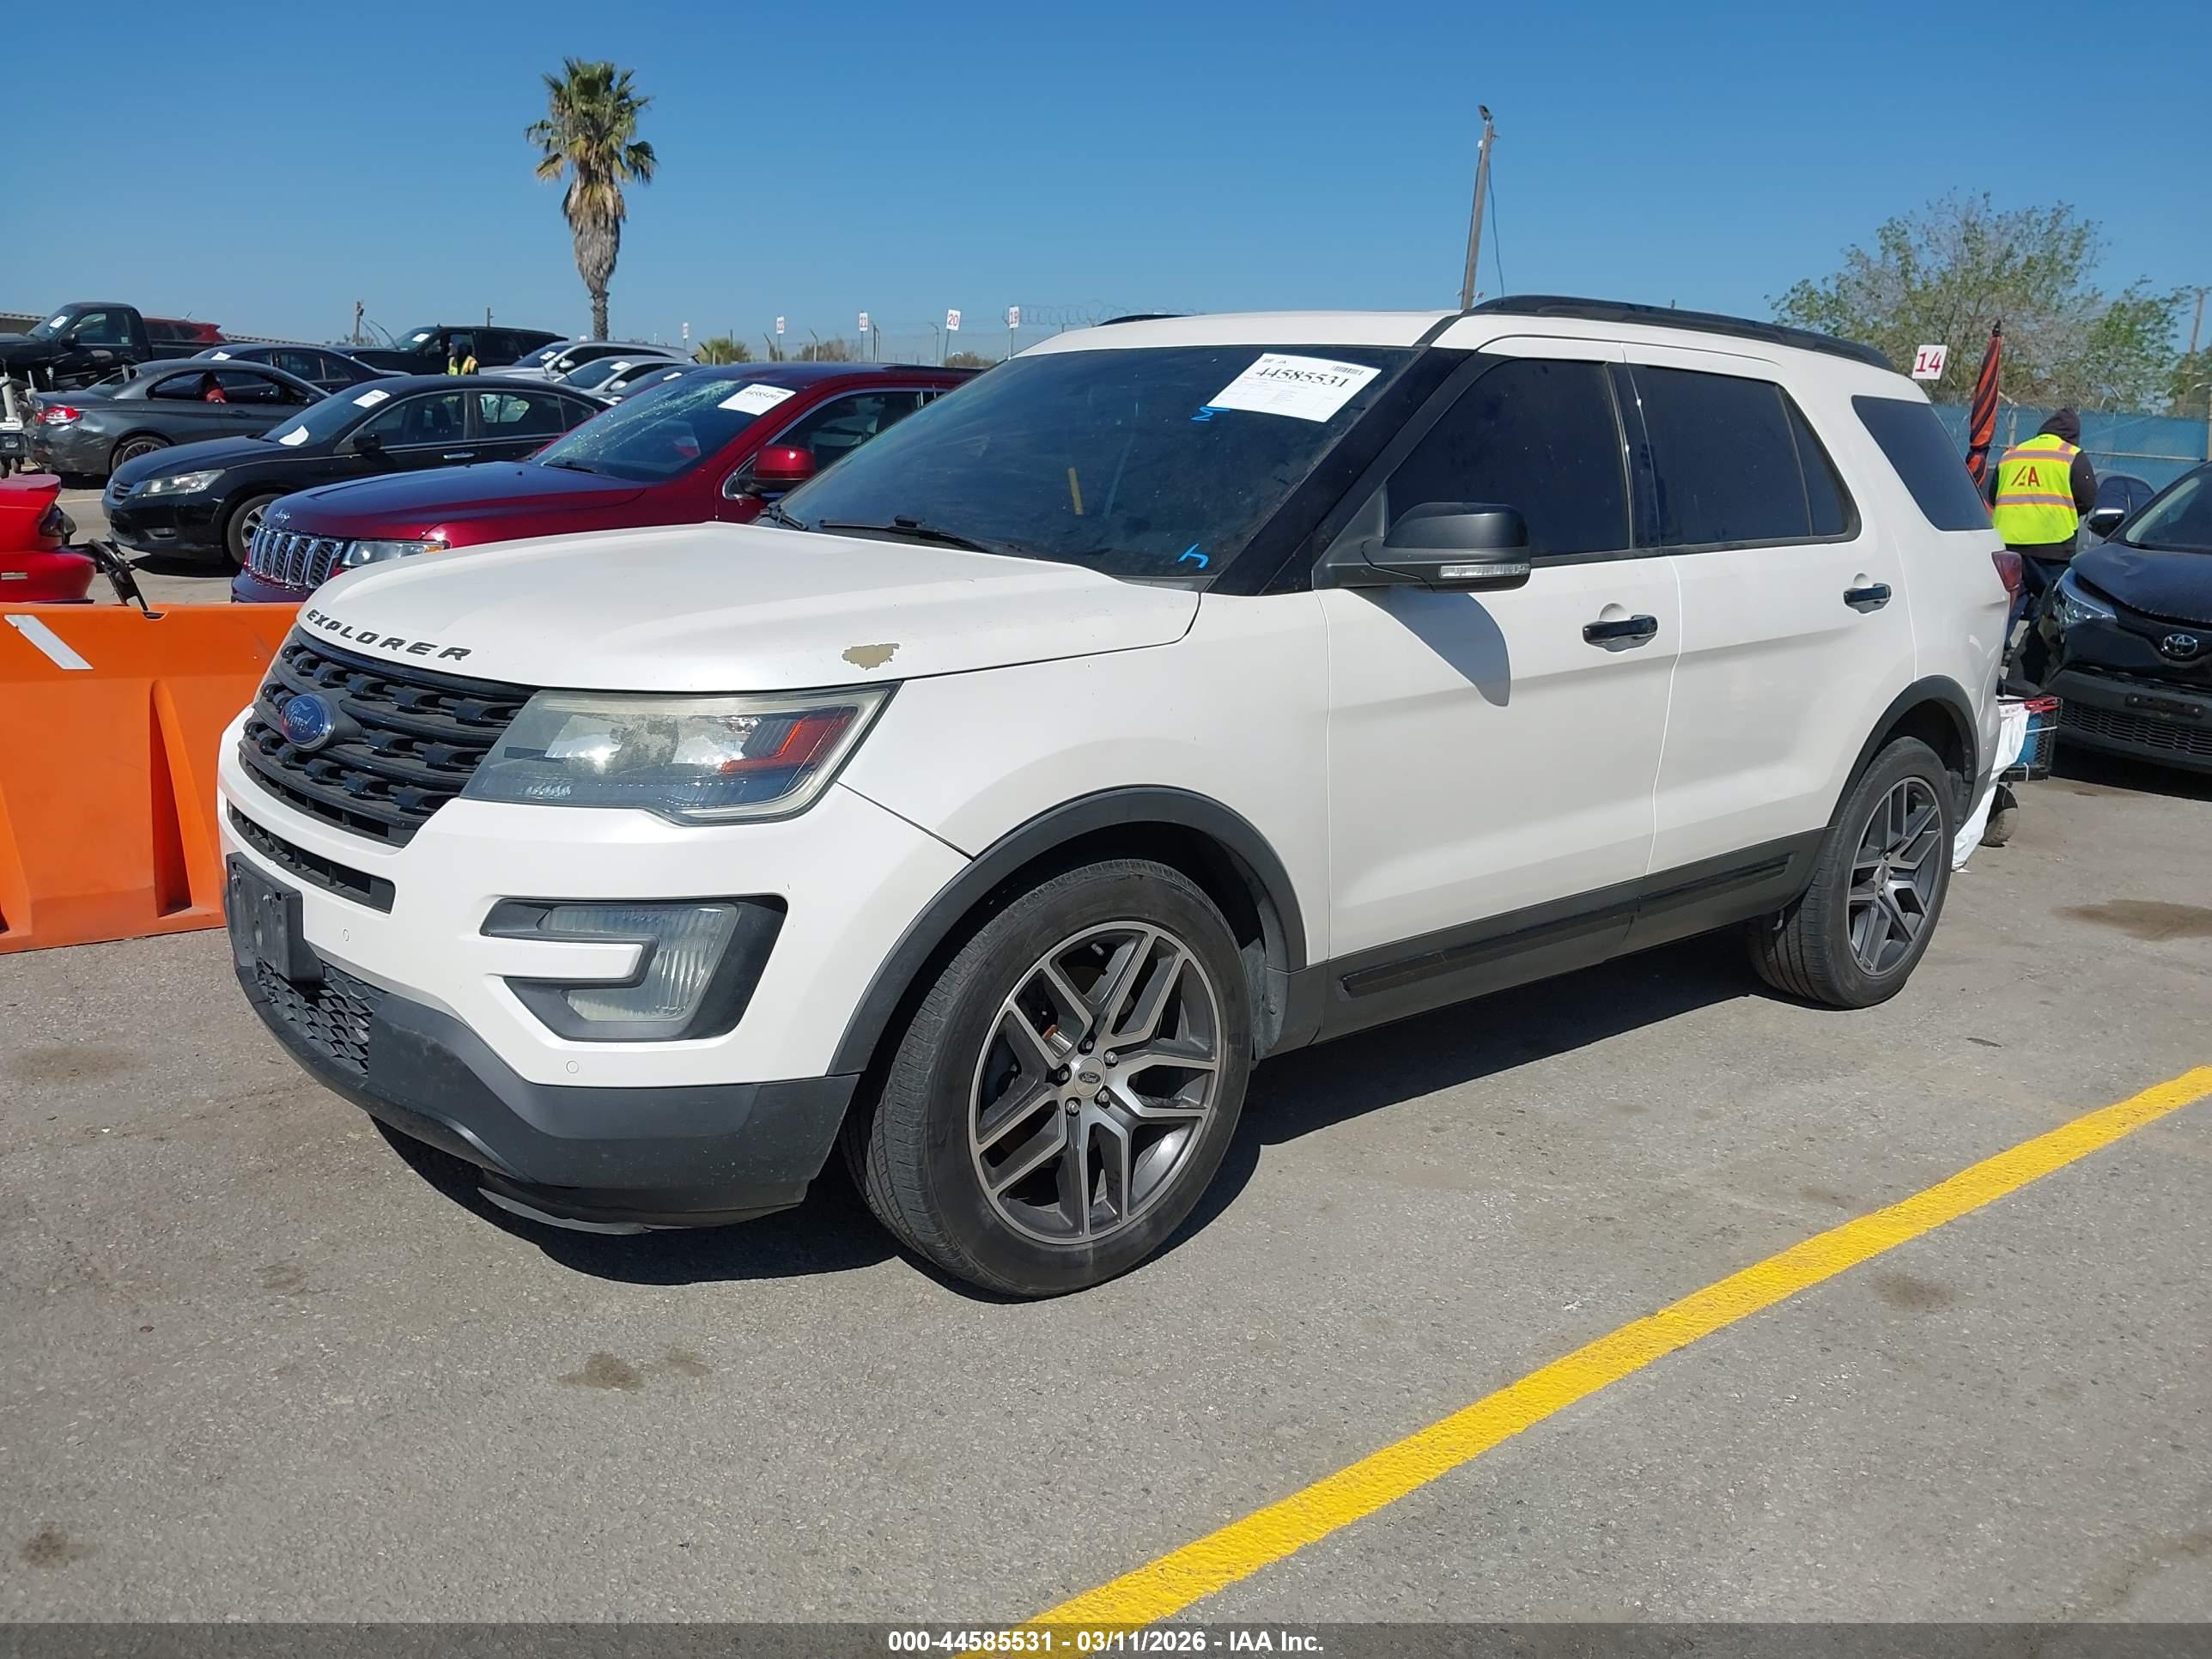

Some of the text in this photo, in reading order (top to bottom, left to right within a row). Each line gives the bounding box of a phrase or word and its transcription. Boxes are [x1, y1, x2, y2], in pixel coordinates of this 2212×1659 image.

[947, 313, 958, 326] 20
[1915, 351, 1942, 373] 14
[1256, 367, 1351, 388] 44585531
[306, 609, 472, 661] EXPLORER
[283, 701, 315, 729] Ford
